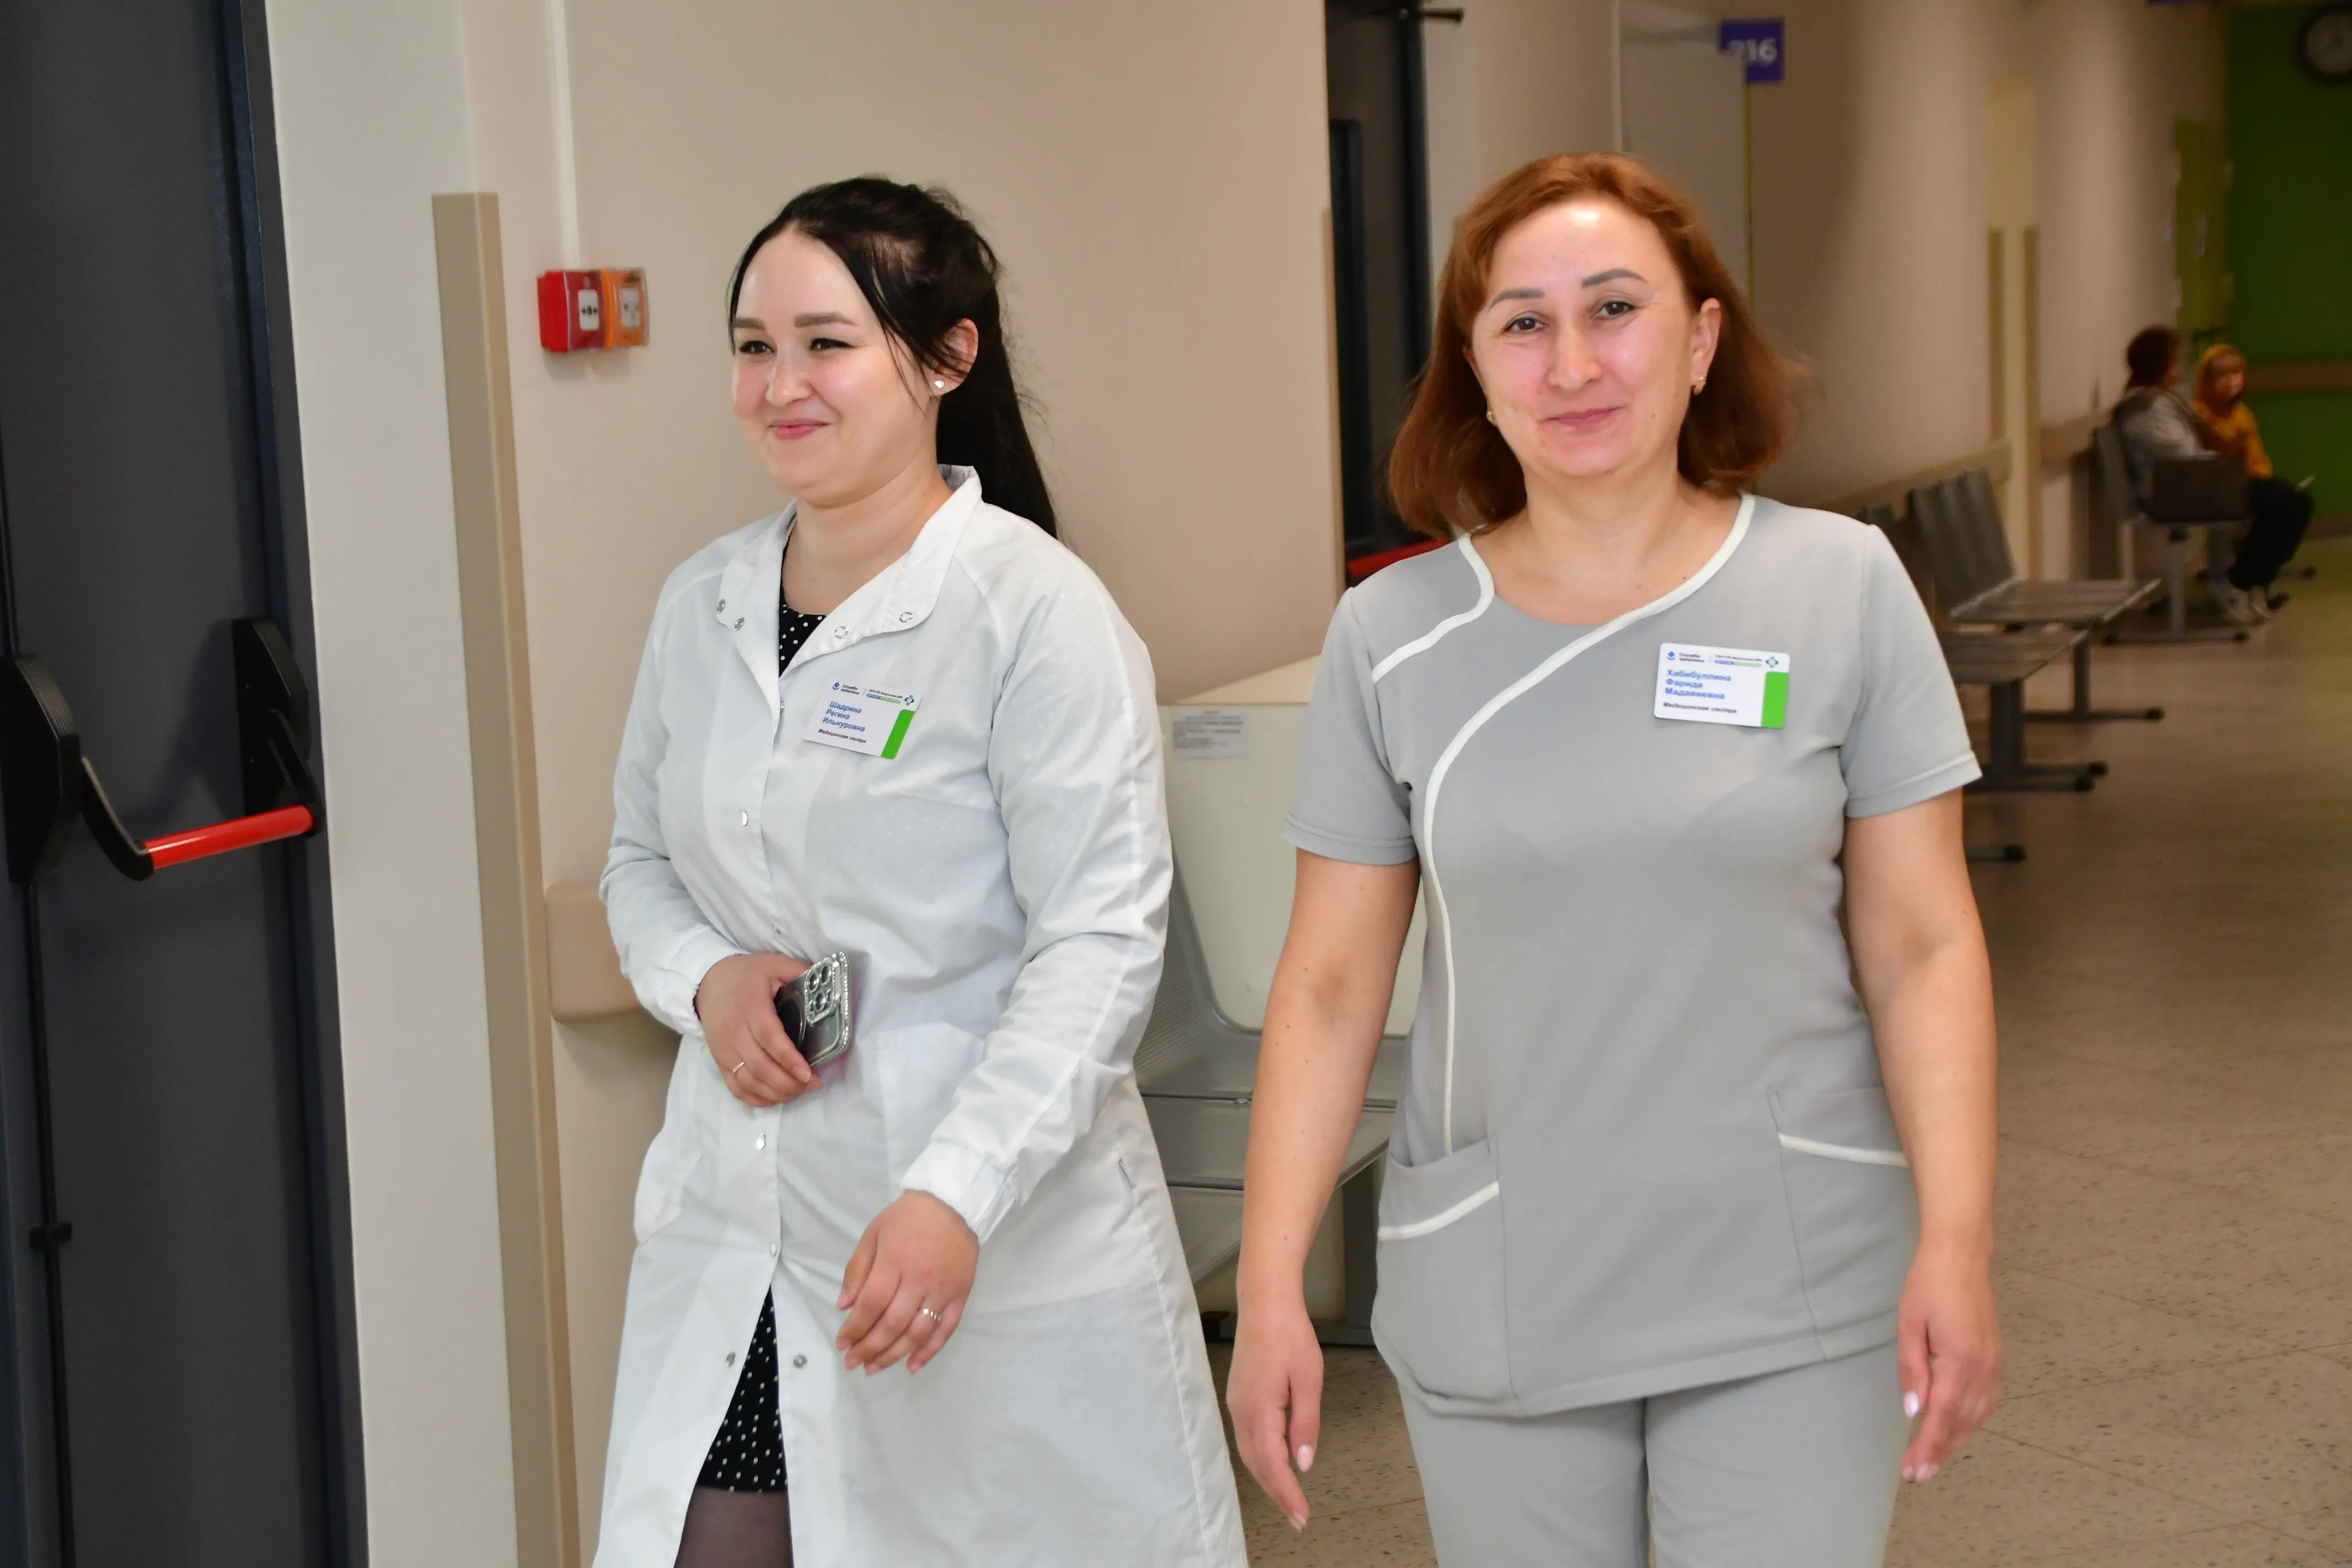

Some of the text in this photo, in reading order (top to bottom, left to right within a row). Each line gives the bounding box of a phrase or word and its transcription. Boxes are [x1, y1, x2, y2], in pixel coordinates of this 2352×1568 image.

[1667, 669, 1731, 681] Хабибуллина
[1666, 678, 1703, 688] Фарида
[829, 701, 862, 714] Шадрина
[826, 709, 849, 720] Регина
[822, 716, 866, 732] Ильнуровна
[818, 728, 848, 739] Медицинская
